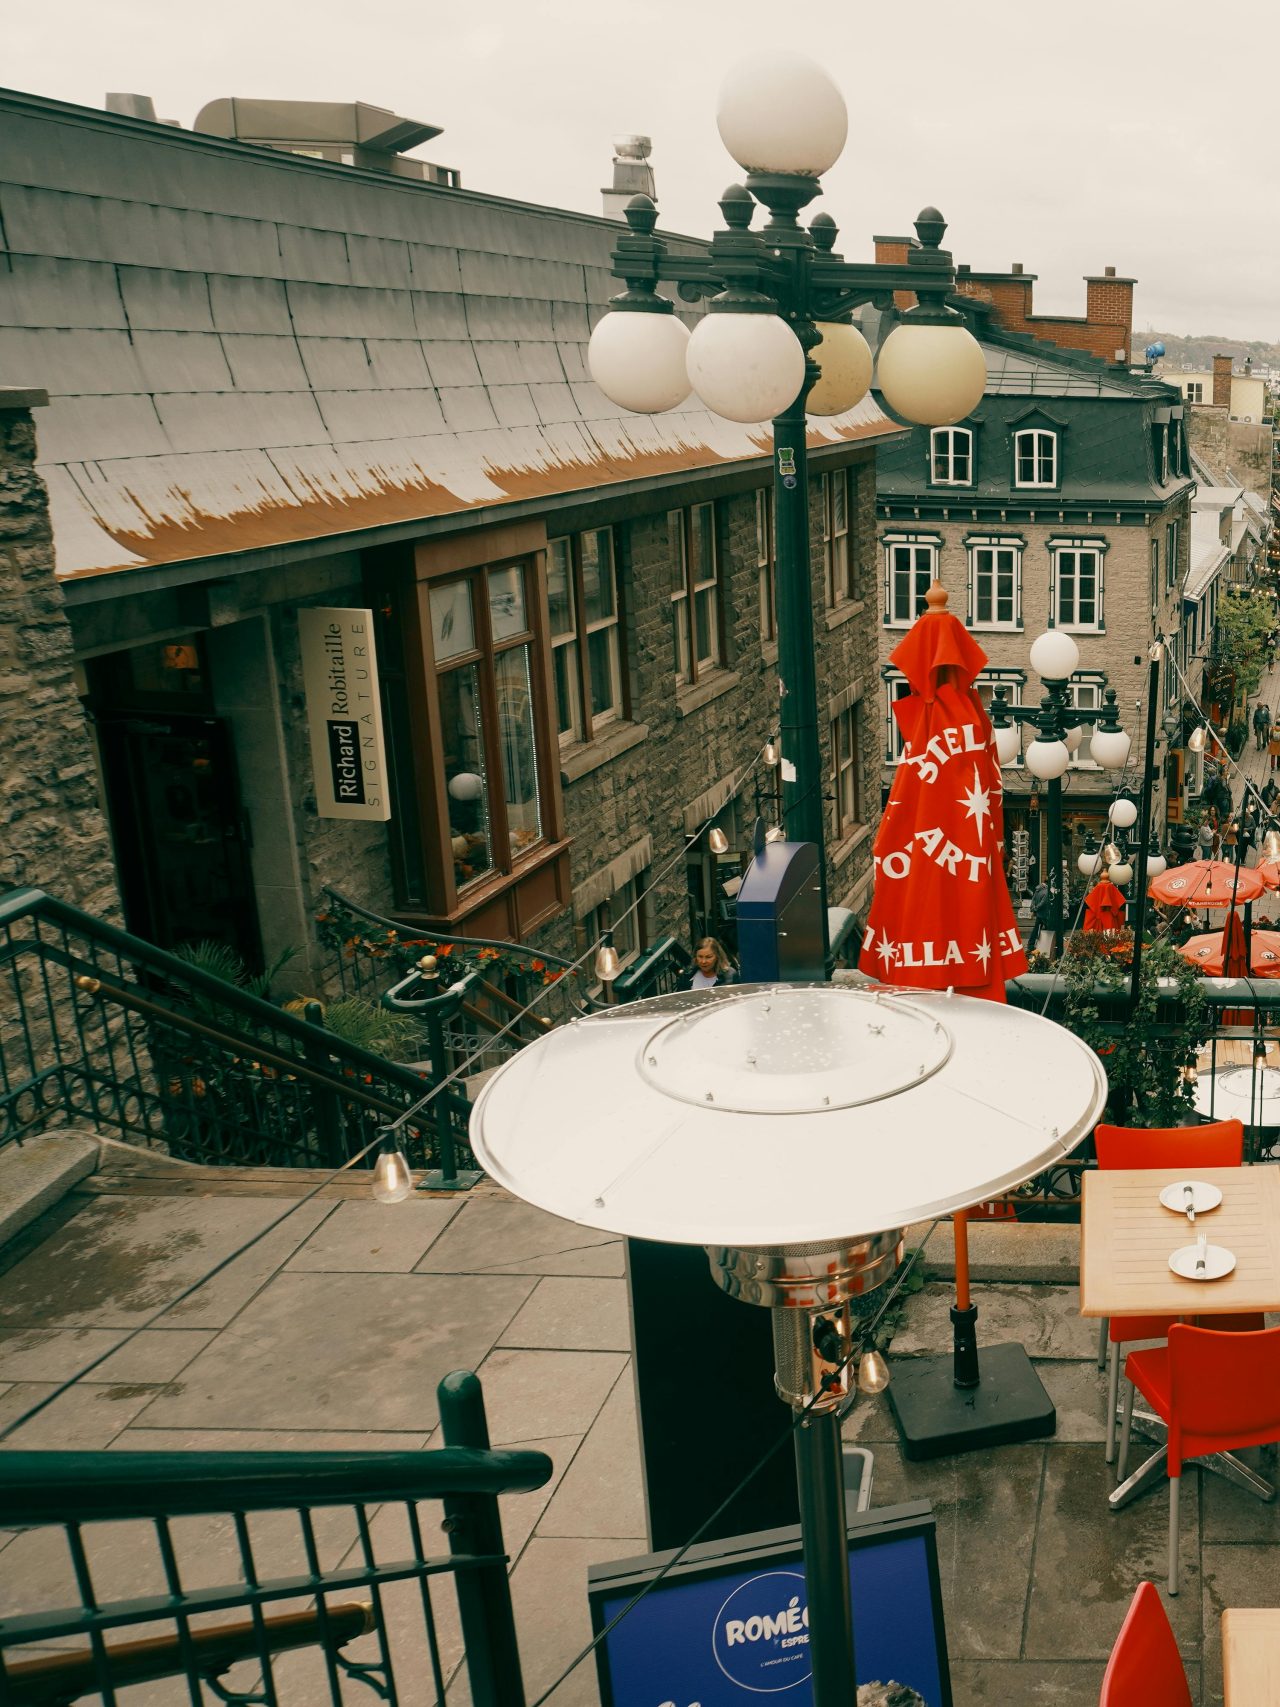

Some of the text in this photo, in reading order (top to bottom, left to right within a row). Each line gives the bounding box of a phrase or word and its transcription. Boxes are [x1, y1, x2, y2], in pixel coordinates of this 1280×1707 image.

[324, 622, 359, 797] Richard Robitaille
[351, 623, 381, 807] SIGNATURE
[914, 826, 992, 883] ART
